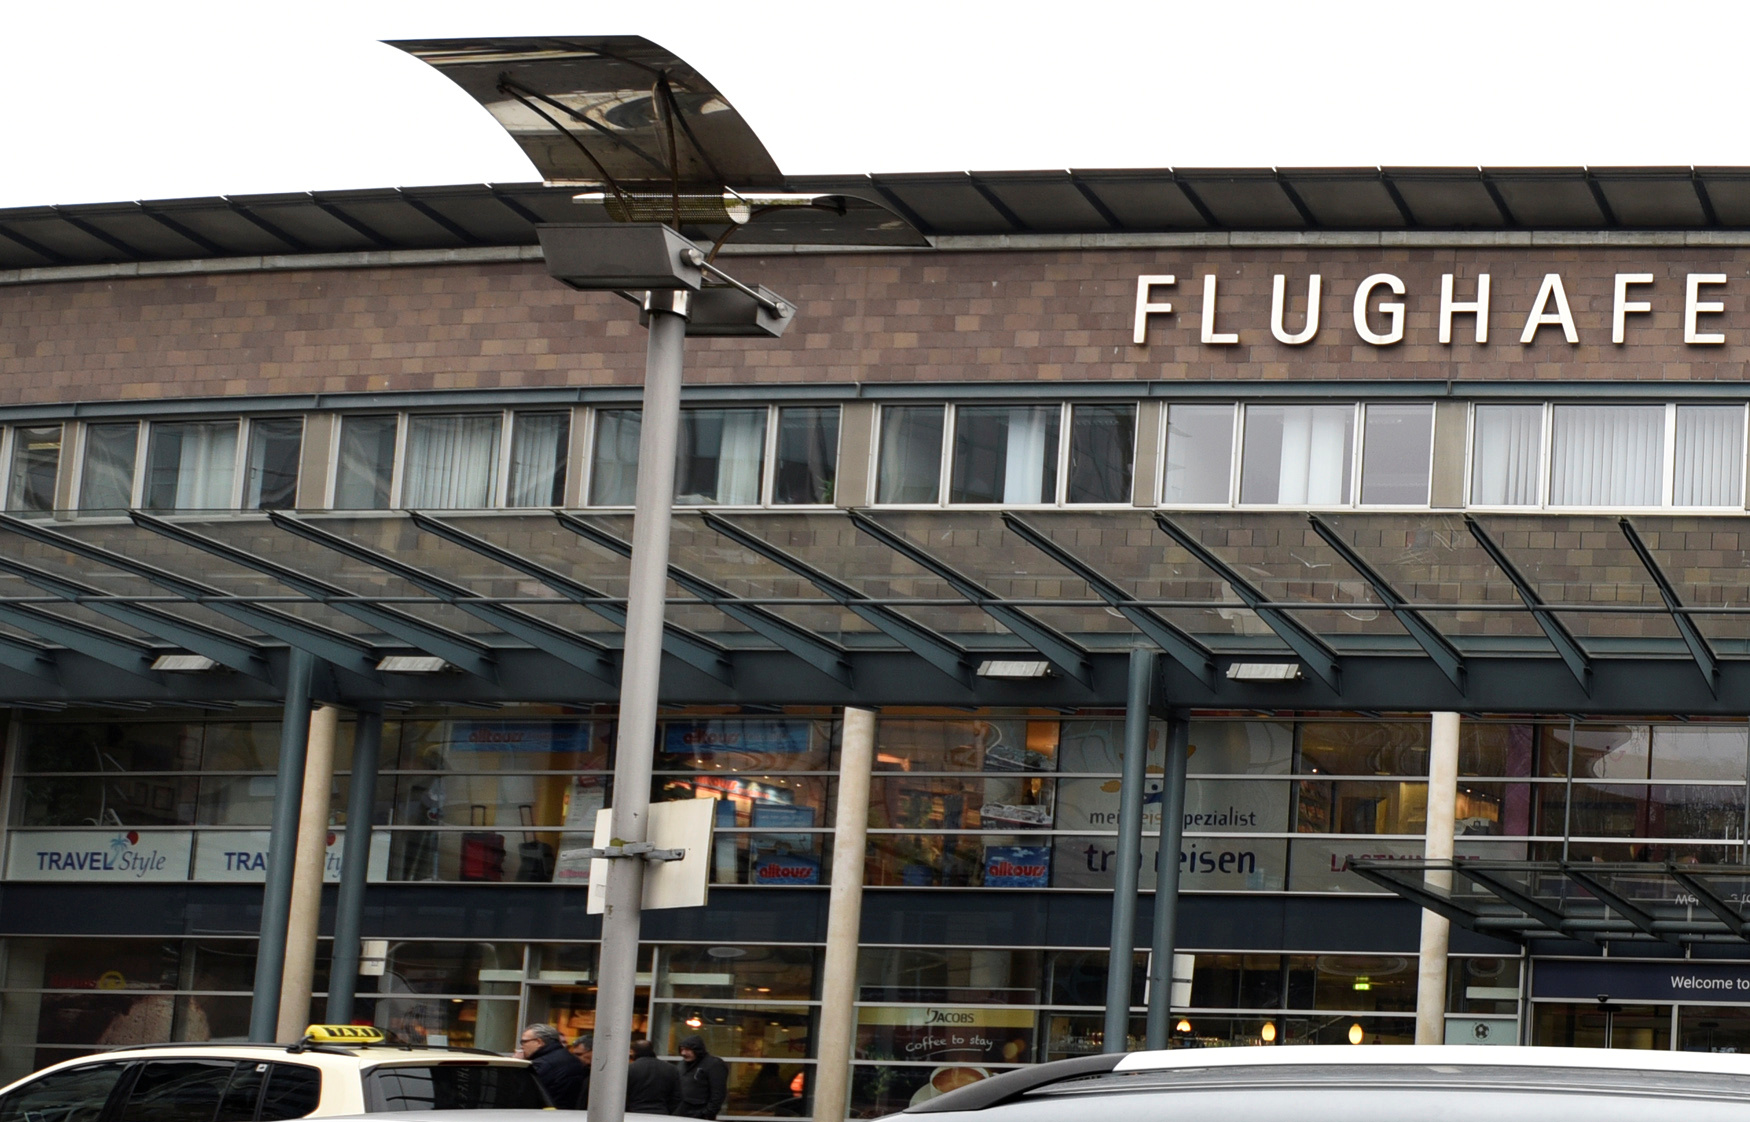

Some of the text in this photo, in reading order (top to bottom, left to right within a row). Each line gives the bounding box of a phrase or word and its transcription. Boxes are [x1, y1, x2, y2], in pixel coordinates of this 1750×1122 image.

[37, 850, 166, 878] TRAVEL Style
[224, 852, 270, 871] TRA
[988, 861, 1046, 877] alltours
[759, 863, 813, 879] alltours
[1670, 976, 1733, 990] Welcome
[1736, 978, 1750, 990] to
[925, 1008, 975, 1024] JACOBS
[331, 1027, 377, 1038] TAXI
[952, 1034, 965, 1045] to
[969, 1035, 994, 1052] stay
